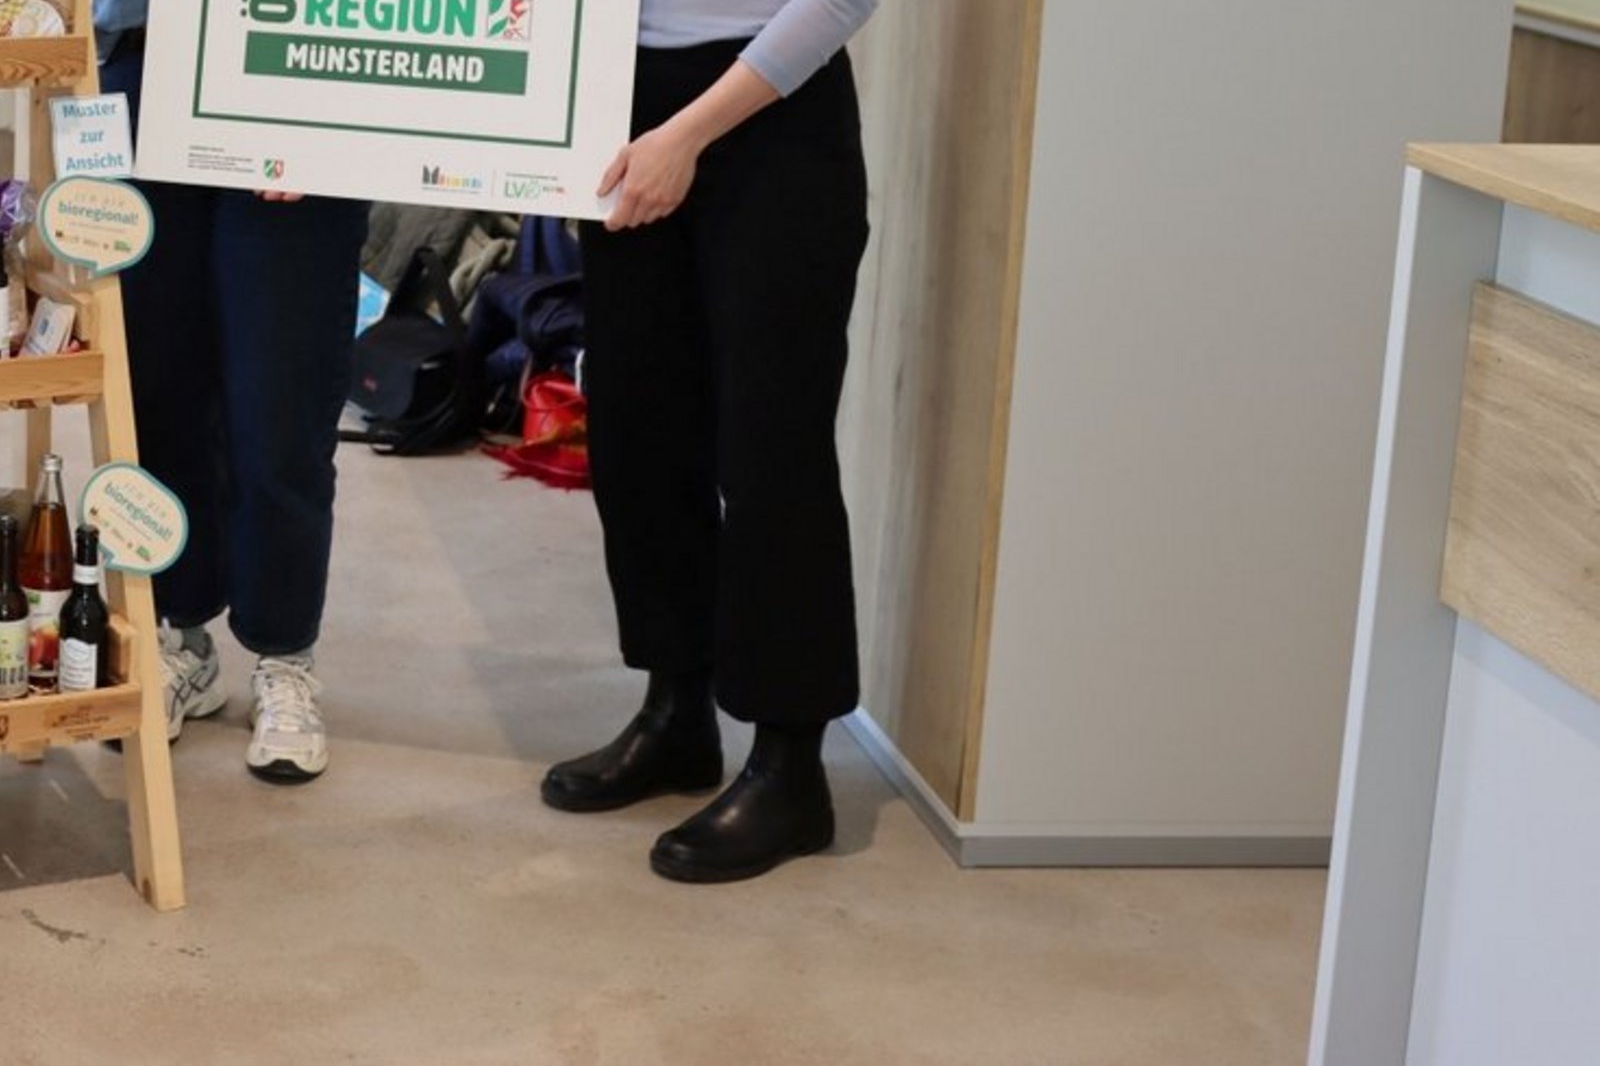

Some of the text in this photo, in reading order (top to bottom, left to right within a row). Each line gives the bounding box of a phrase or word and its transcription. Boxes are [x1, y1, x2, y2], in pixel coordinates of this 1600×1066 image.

[285, 43, 485, 83] MÜNSTERLAND
[61, 103, 118, 119] Muster
[79, 130, 105, 144] zur
[65, 153, 125, 171] Ansicht
[58, 200, 140, 226] bioregional!
[104, 482, 174, 541] bioregional!
